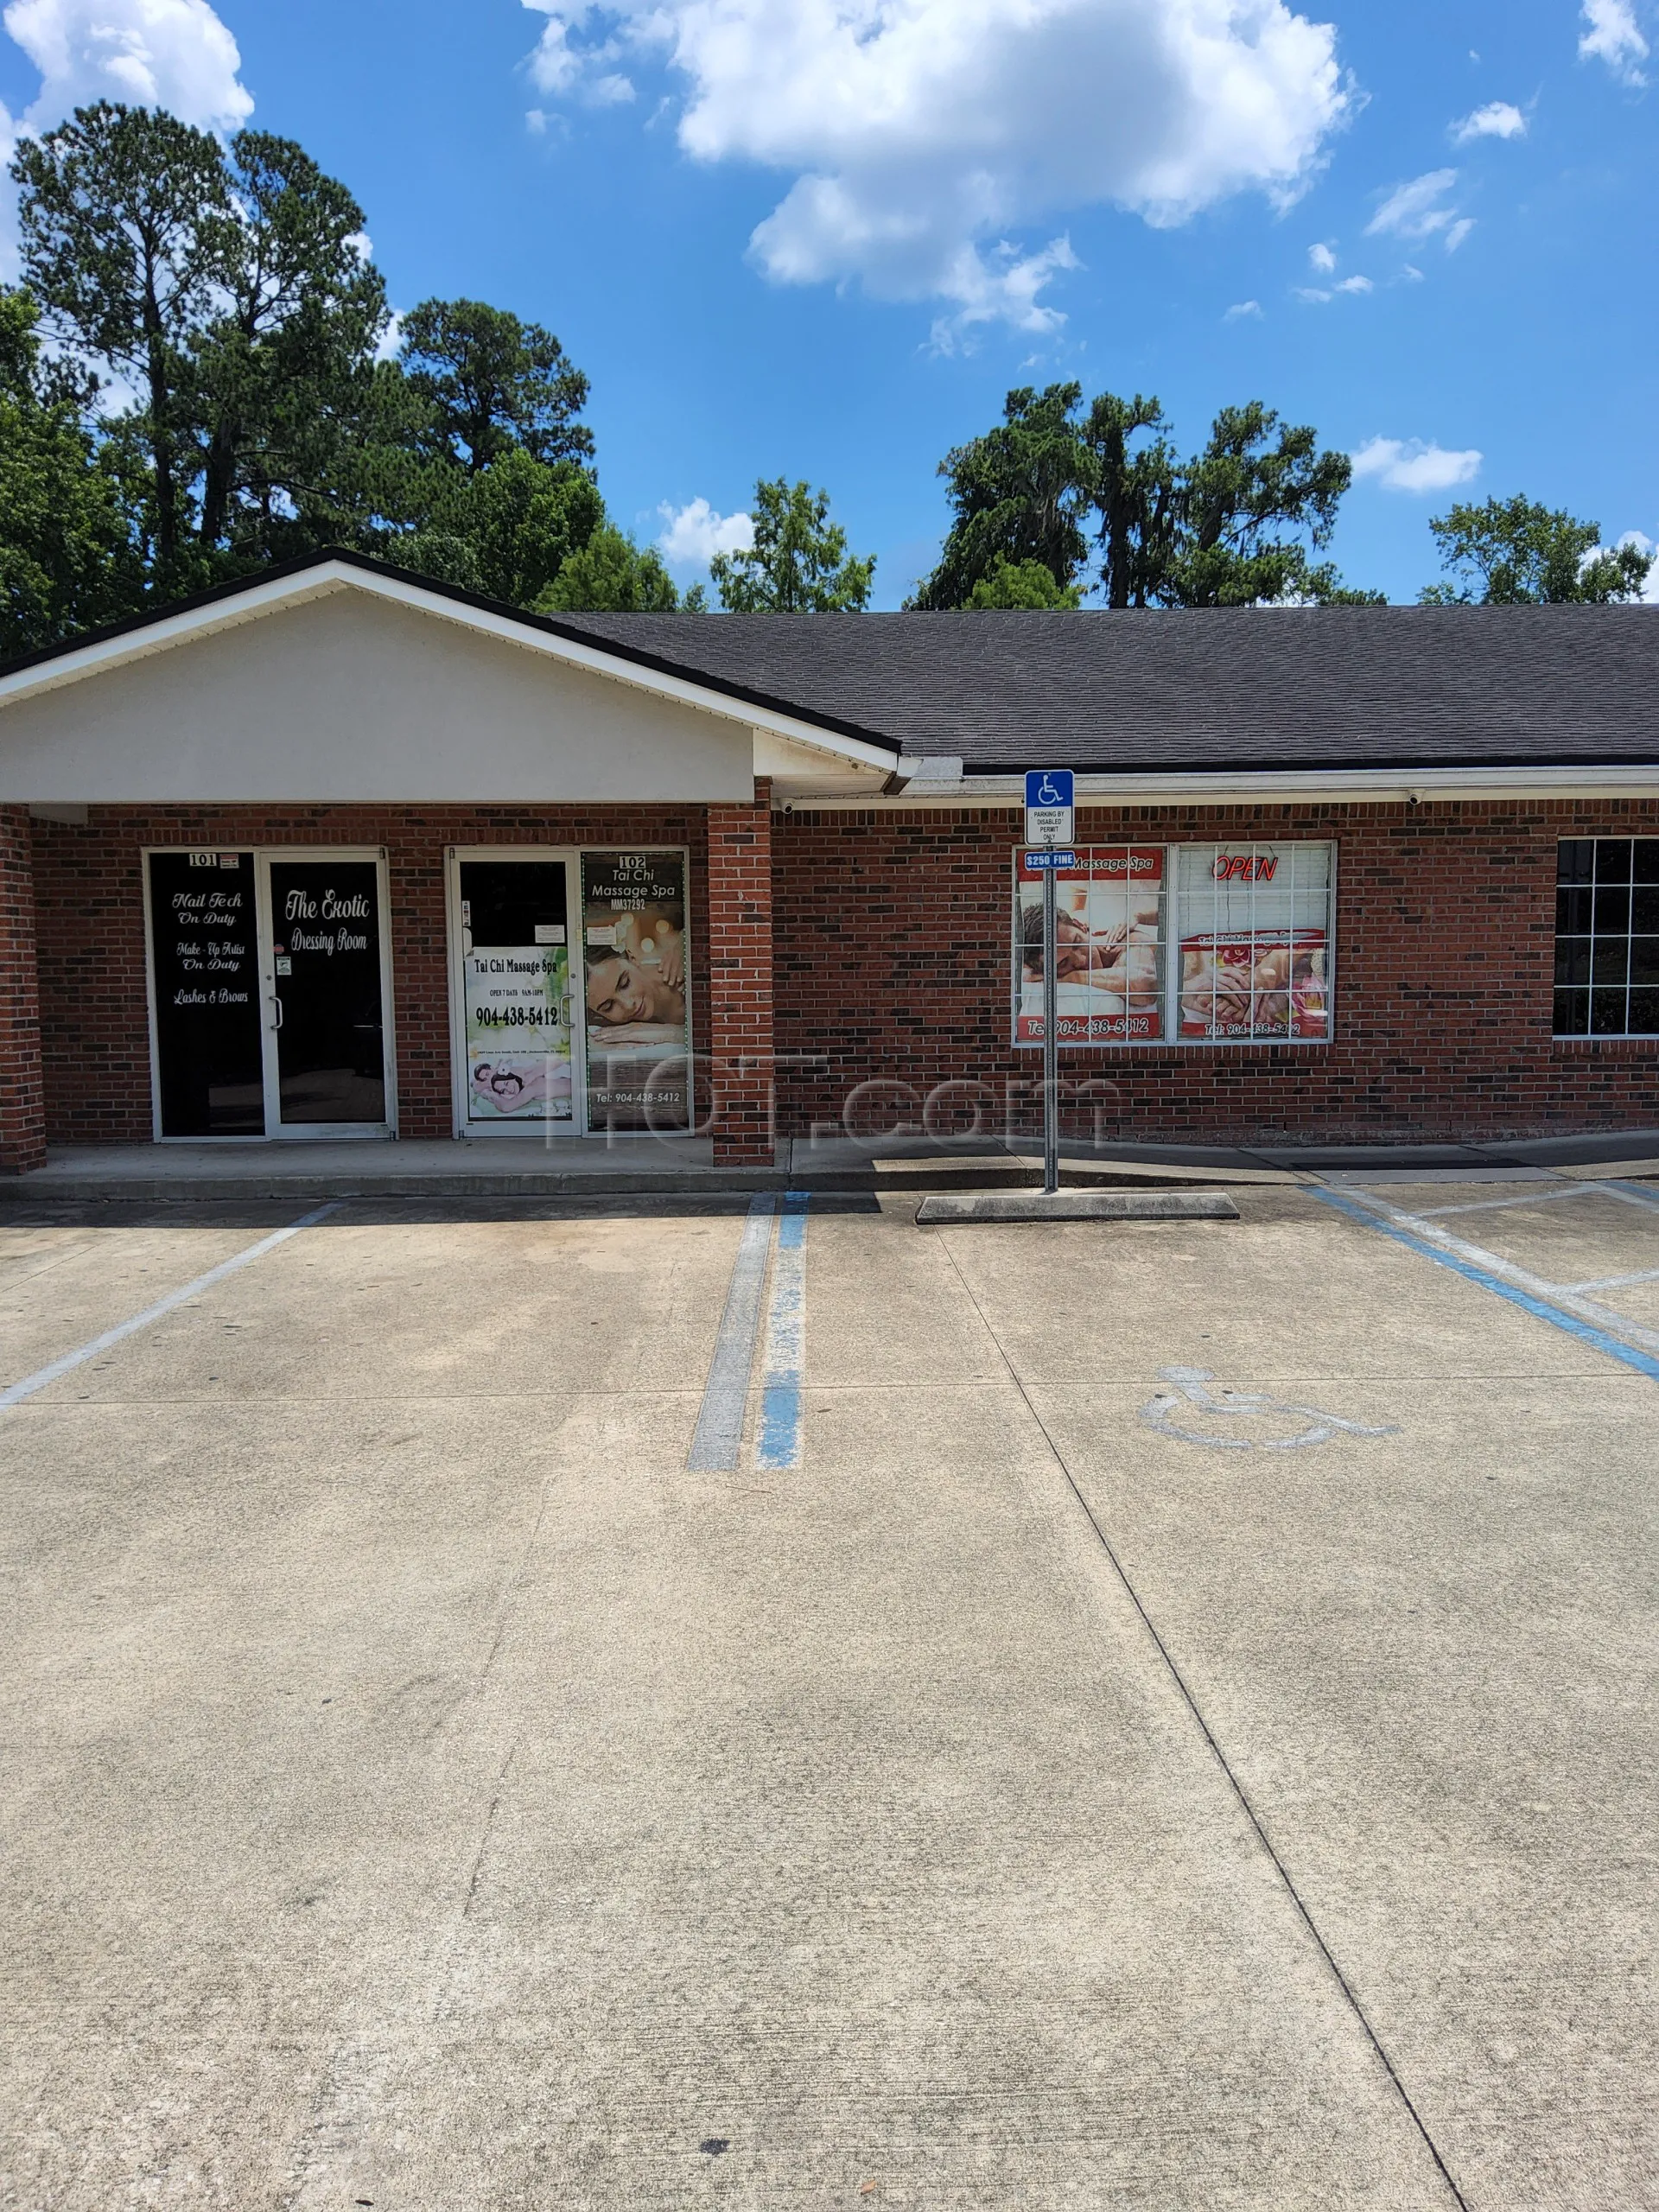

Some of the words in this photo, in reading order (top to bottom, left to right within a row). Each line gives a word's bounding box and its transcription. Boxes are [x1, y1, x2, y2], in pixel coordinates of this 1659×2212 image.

[191, 854, 215, 866] 101
[621, 856, 645, 868] 102
[1027, 855, 1051, 866] $250
[1053, 854, 1073, 865] FINE
[1074, 856, 1127, 872] Massage
[1128, 855, 1154, 872] Spa
[612, 869, 631, 881] Tai
[633, 869, 655, 881] Chi
[1212, 855, 1279, 881] OPEN
[591, 885, 649, 899] Massage
[652, 884, 676, 898] Spa
[172, 893, 207, 908] Nail
[208, 892, 243, 908] Tech
[285, 889, 318, 920] The
[321, 888, 370, 920] Exotic
[611, 899, 646, 911] MM37292
[178, 912, 200, 925] On
[203, 912, 237, 926] Duty
[176, 942, 200, 956] Make
[222, 941, 245, 956] Artist
[291, 927, 335, 957] Dressing
[337, 927, 368, 950] Room
[182, 958, 205, 969] On
[207, 958, 241, 972] Duty
[474, 959, 488, 973] Tai
[490, 958, 505, 973] Chi
[506, 958, 540, 976] Massage
[542, 958, 557, 976] Spa
[174, 988, 207, 1005] Lashes
[208, 990, 217, 1004] &
[219, 988, 249, 1003] Brows
[475, 1006, 558, 1027] 904-438-5412
[1227, 1022, 1300, 1036] 904-438-542
[596, 1093, 613, 1103] Tel:
[615, 1092, 680, 1103] 904-438-5412
